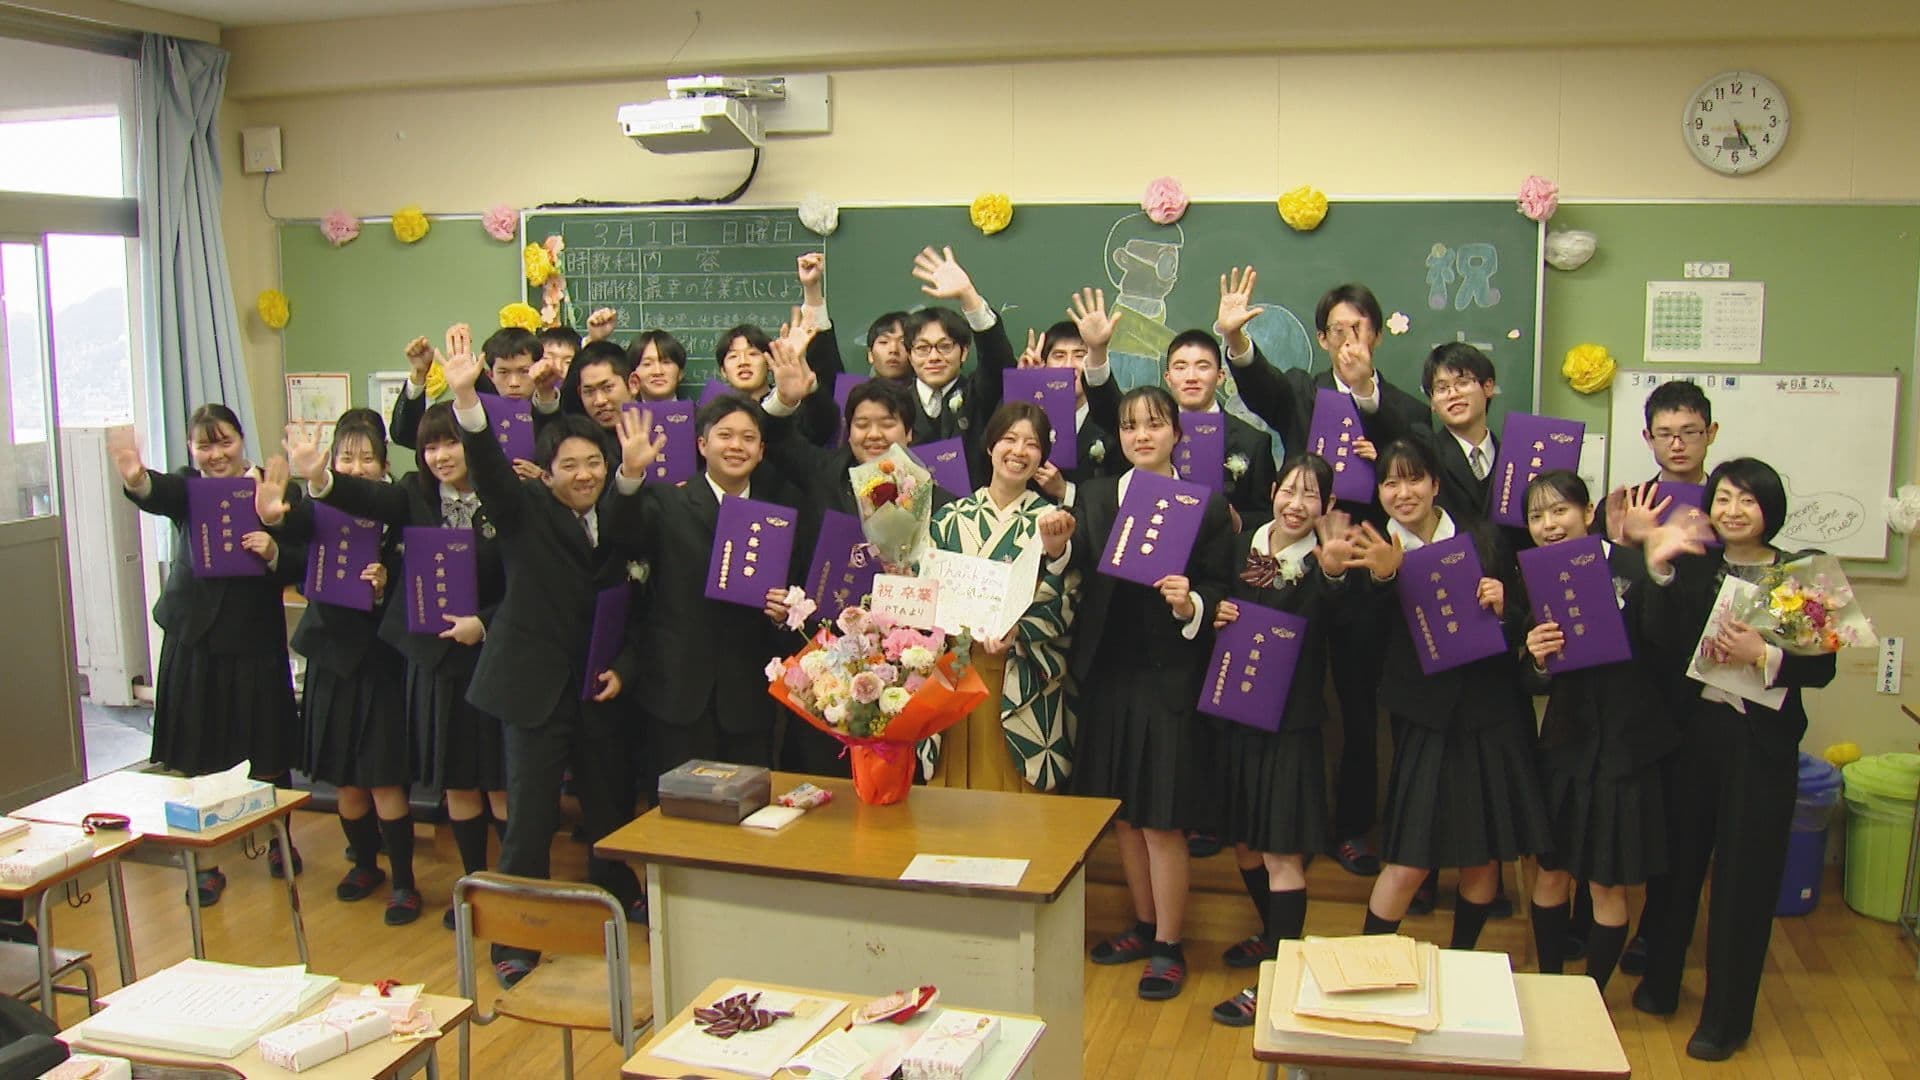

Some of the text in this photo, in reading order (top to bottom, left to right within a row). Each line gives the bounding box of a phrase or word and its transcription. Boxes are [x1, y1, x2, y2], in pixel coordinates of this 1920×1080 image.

[1714, 88, 1724, 99] 11
[1730, 82, 1743, 95] 12
[1752, 87, 1756, 97] 1
[1700, 99, 1713, 112] 10
[1763, 98, 1772, 110] 2
[1695, 117, 1703, 129] 9
[1769, 116, 1776, 127] 3
[1701, 135, 1709, 146] 8
[1763, 134, 1770, 143] 4
[1715, 146, 1723, 157] 7
[1731, 151, 1739, 164] 6
[594, 218, 793, 247] 3月1日 日曜日
[591, 250, 638, 272] 教科
[1425, 242, 1501, 310] 祝
